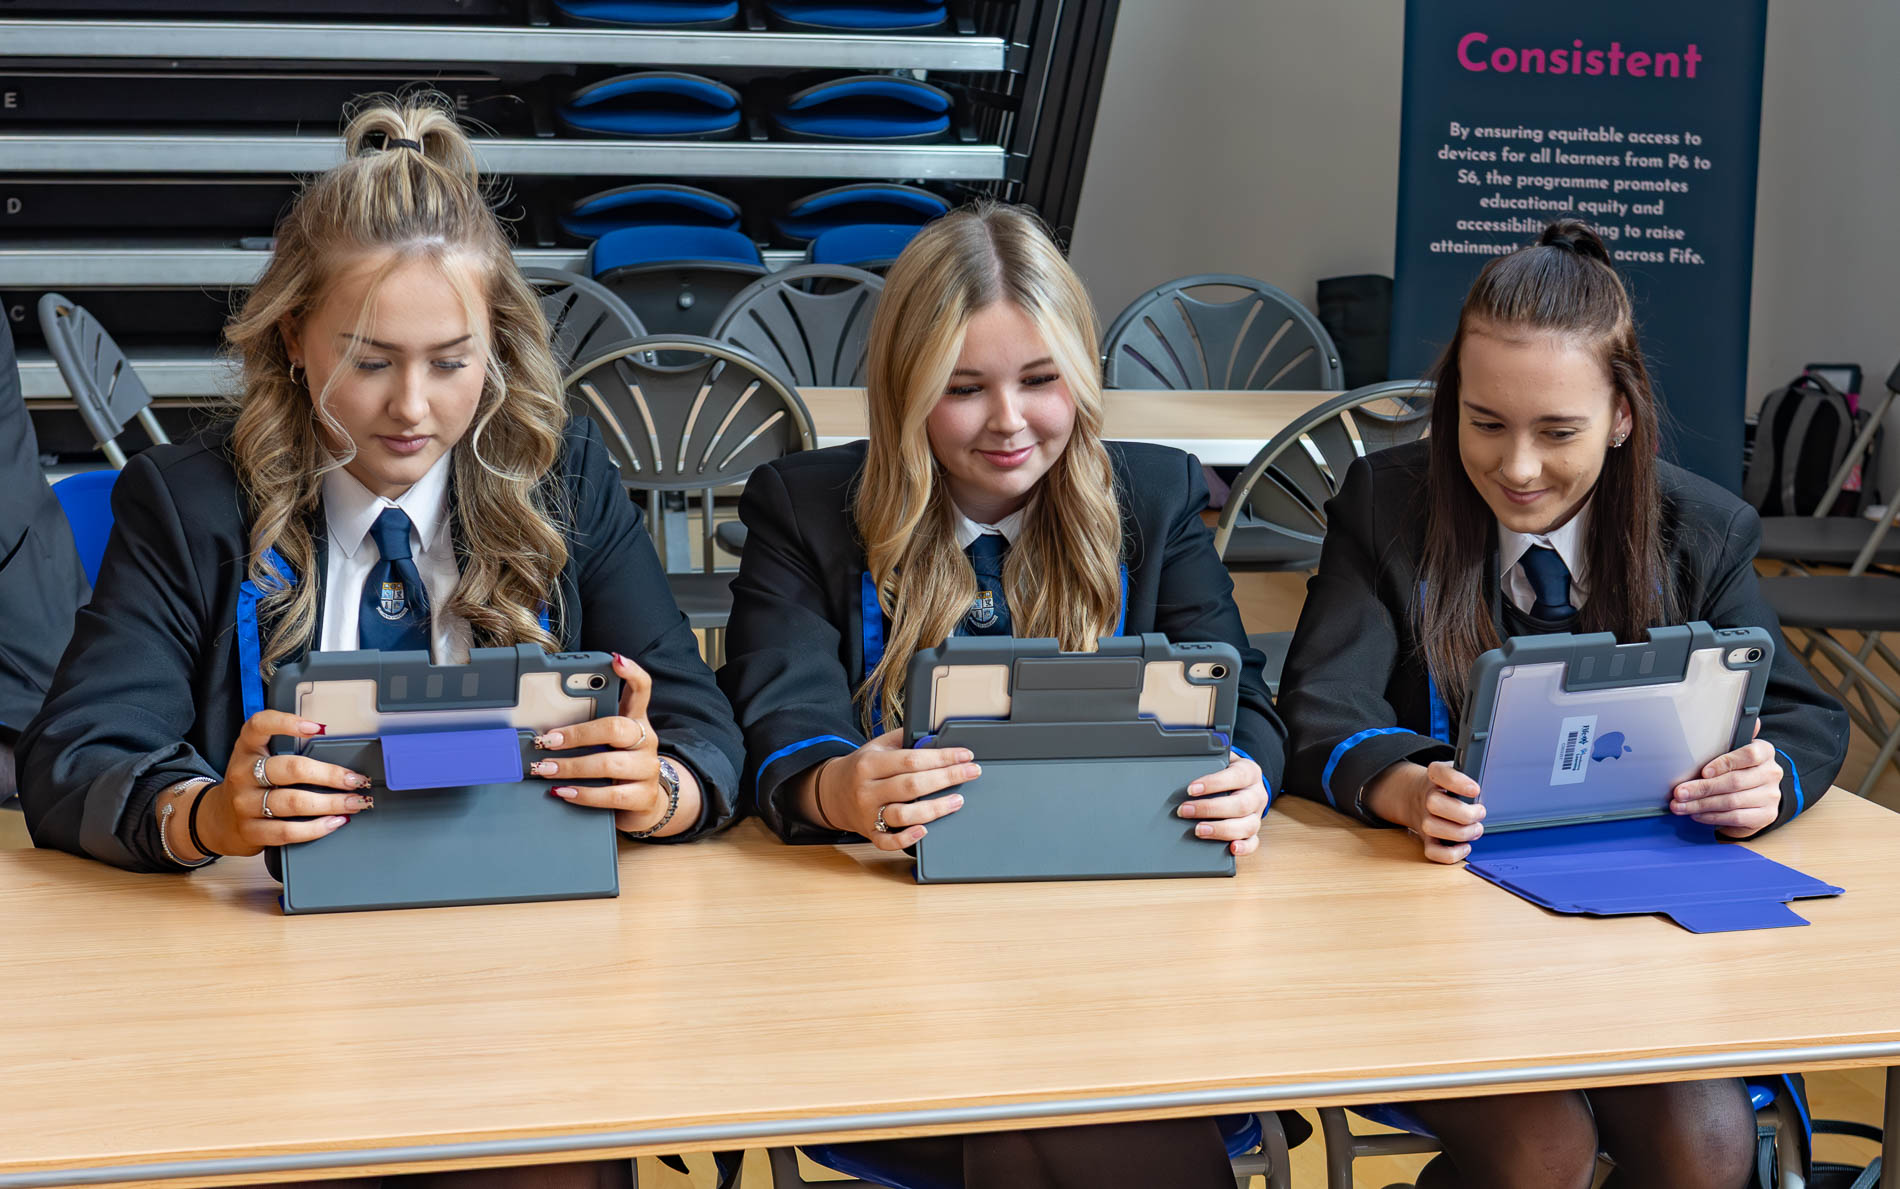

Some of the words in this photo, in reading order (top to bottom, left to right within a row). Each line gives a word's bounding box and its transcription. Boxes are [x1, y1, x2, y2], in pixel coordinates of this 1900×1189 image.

[1457, 32, 1702, 78] Consistent
[4, 92, 17, 108] E
[1449, 121, 1470, 140] By
[1474, 125, 1544, 143] ensuring
[1548, 126, 1624, 144] equitable
[1628, 132, 1680, 145] access
[1685, 131, 1702, 146] to
[1438, 144, 1497, 161] devices
[1501, 146, 1526, 162] for
[1530, 147, 1551, 163] all
[1555, 148, 1620, 166] learners
[1624, 150, 1663, 168] from
[1668, 152, 1689, 169] P6
[1694, 155, 1711, 170] to
[1457, 168, 1481, 186] S6,
[1486, 168, 1512, 185] the
[1517, 174, 1610, 190] programme
[1613, 178, 1689, 193] promotes
[7, 197, 22, 214] D
[1479, 192, 1573, 211] educational
[1577, 199, 1628, 217] equity
[1632, 199, 1664, 215] and
[1624, 223, 1641, 238] to
[1645, 225, 1685, 240] raise
[1614, 249, 1665, 262] across
[1669, 247, 1705, 264] Fife.
